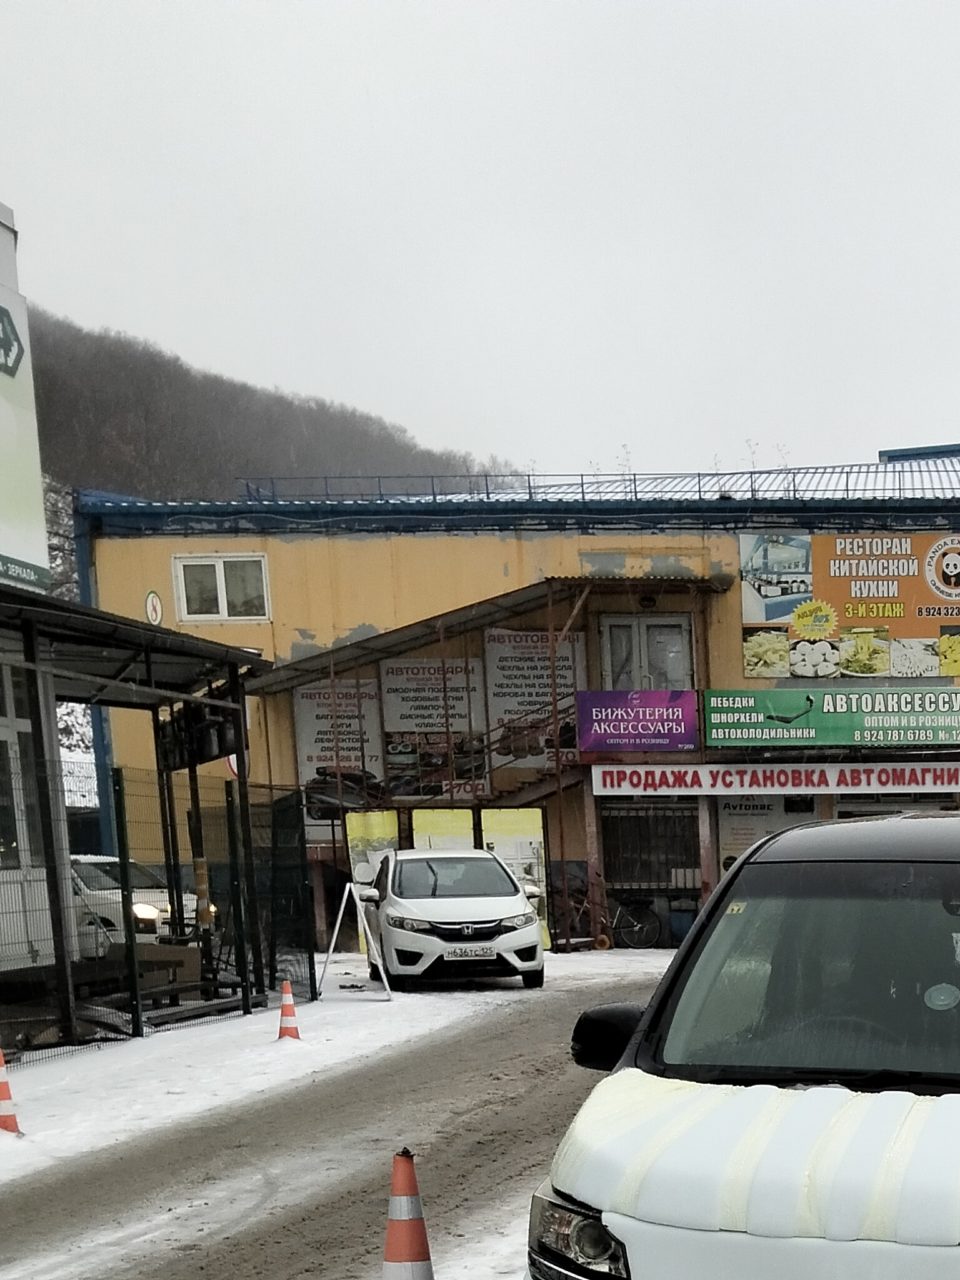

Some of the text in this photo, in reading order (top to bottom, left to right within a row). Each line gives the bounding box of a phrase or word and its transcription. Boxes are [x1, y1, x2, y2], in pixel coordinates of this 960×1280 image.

[836, 538, 912, 555] РЕСТОРАН
[927, 539, 949, 567] PANDA
[829, 556, 919, 577] КИТАЙСКОЙ
[851, 580, 898, 598] КУХНИ
[845, 600, 905, 618] 3-Й ЭТАЖ
[917, 606, 924, 617] 8
[925, 606, 942, 617] 924
[943, 606, 960, 617] 323
[711, 697, 755, 708] ЛЕБЕДКИ
[592, 707, 683, 720] БИЖУТЕРИЯ
[711, 713, 764, 723] ШНОРХЕЛИ
[865, 716, 899, 727] ОПТОМ
[901, 716, 908, 726] И
[910, 716, 917, 726] В
[591, 722, 685, 734] АКСЕССУАРЫ
[711, 728, 816, 739] АВТОХОЛОДИЛЬНИКИ
[854, 731, 861, 741] 8
[864, 731, 884, 741] 924
[887, 730, 904, 741] 787
[907, 730, 934, 741] 6789
[602, 770, 702, 791] ПРОДАЖА
[709, 769, 830, 788] УСТАНОВКА
